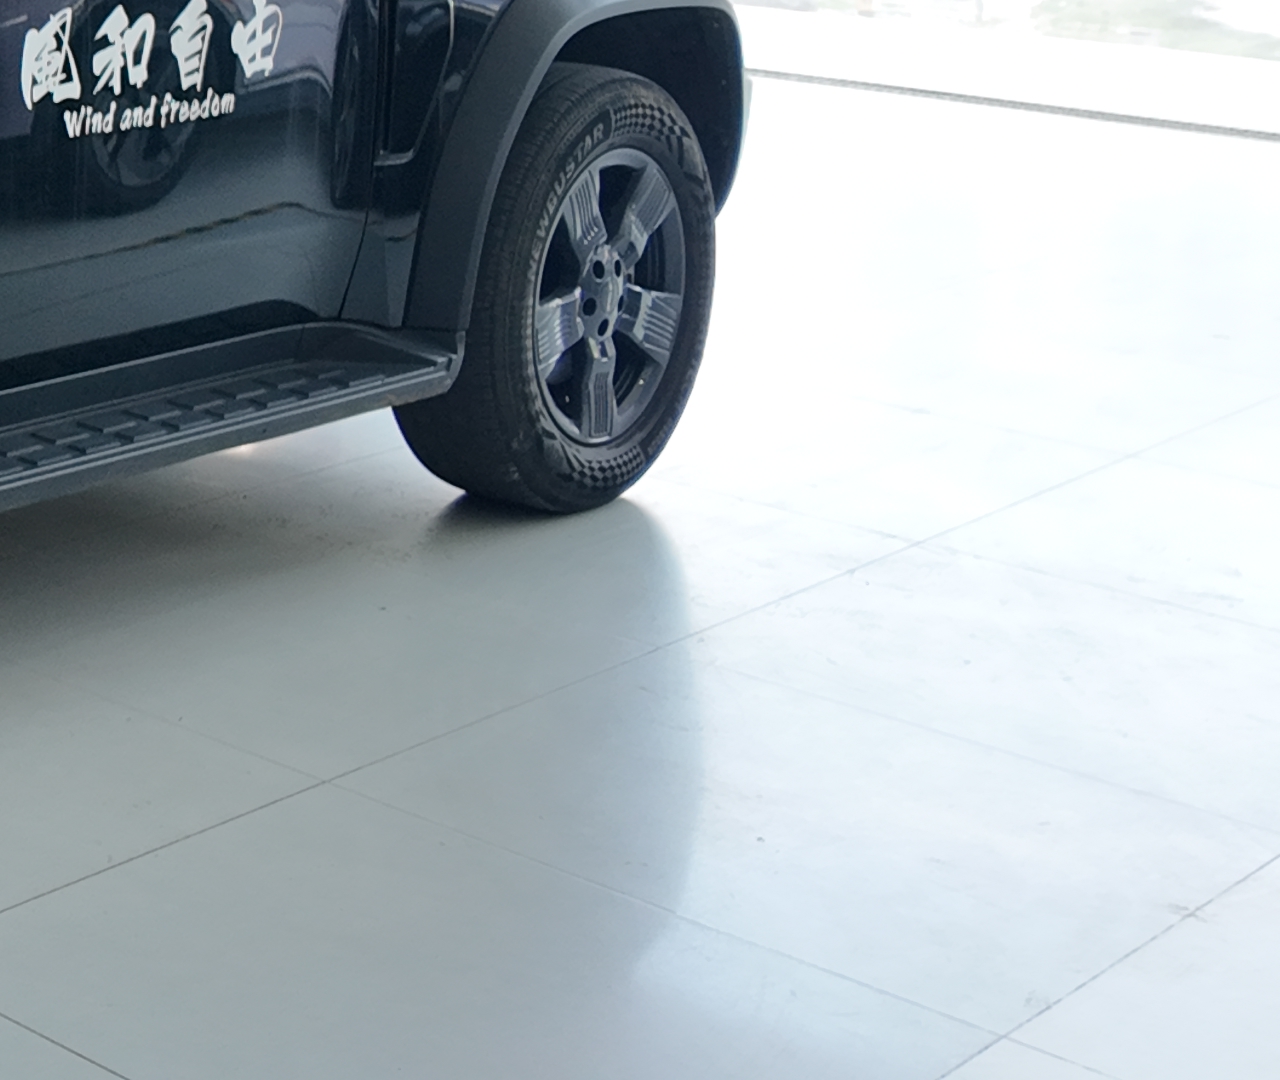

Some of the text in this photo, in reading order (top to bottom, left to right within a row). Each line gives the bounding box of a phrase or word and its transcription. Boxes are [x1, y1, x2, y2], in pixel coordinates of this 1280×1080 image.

[63, 87, 236, 138] Wind and freedom
